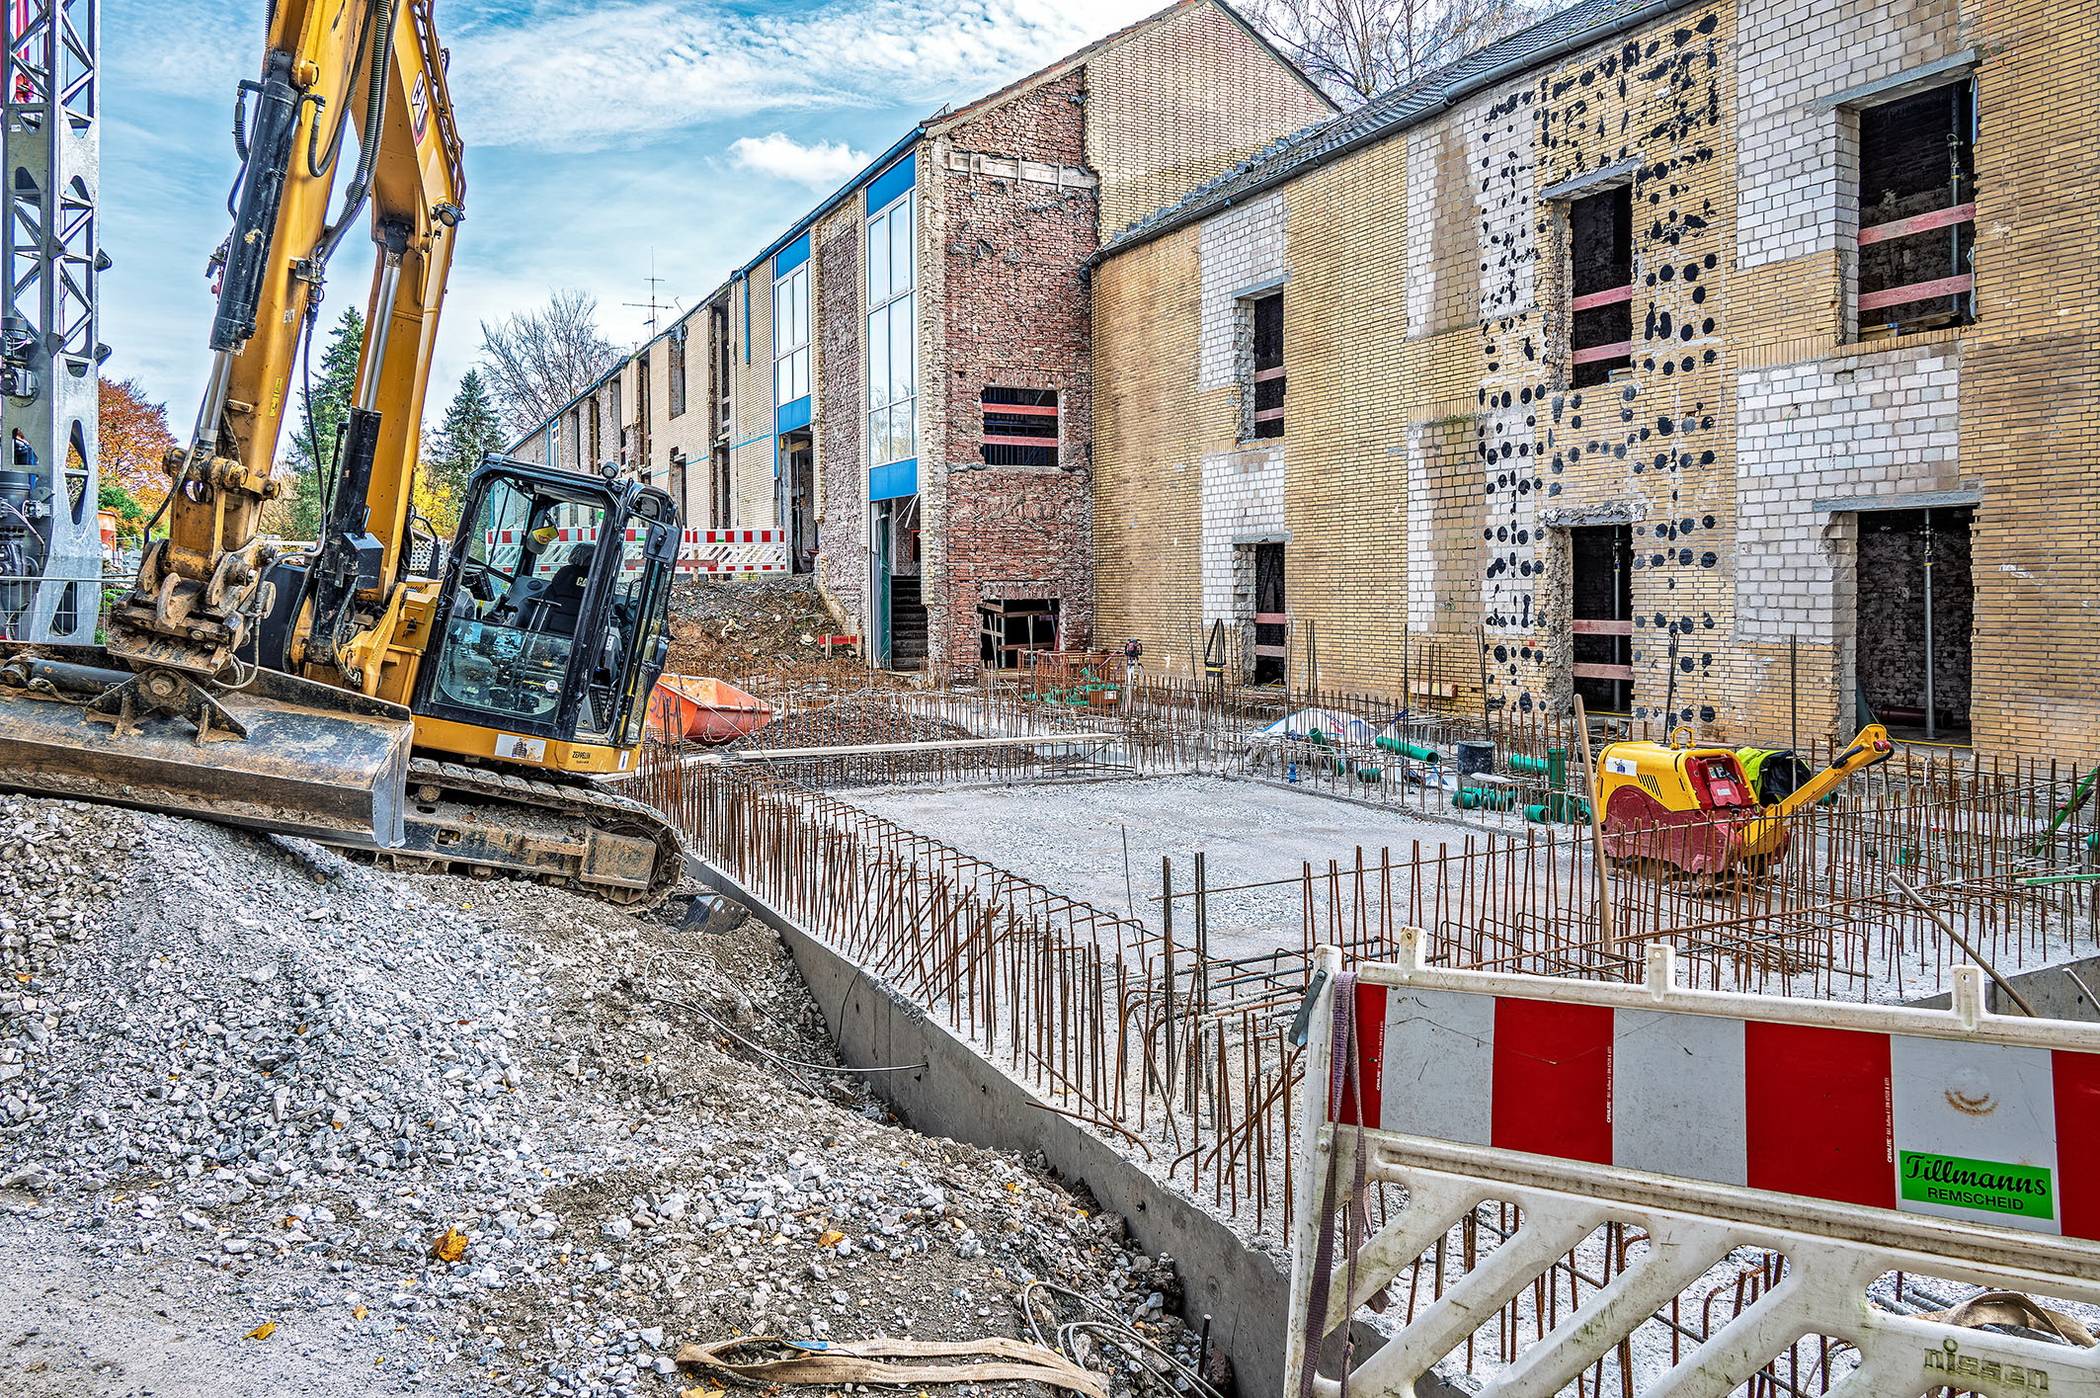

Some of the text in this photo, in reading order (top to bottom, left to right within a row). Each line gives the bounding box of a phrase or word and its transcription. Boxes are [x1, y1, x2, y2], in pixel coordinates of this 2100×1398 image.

[576, 576, 588, 587] CA
[1905, 1155, 2047, 1196] Tillmanns
[1927, 1187, 2024, 1210] REMSCHEID
[1924, 1337, 2049, 1390] nissen
